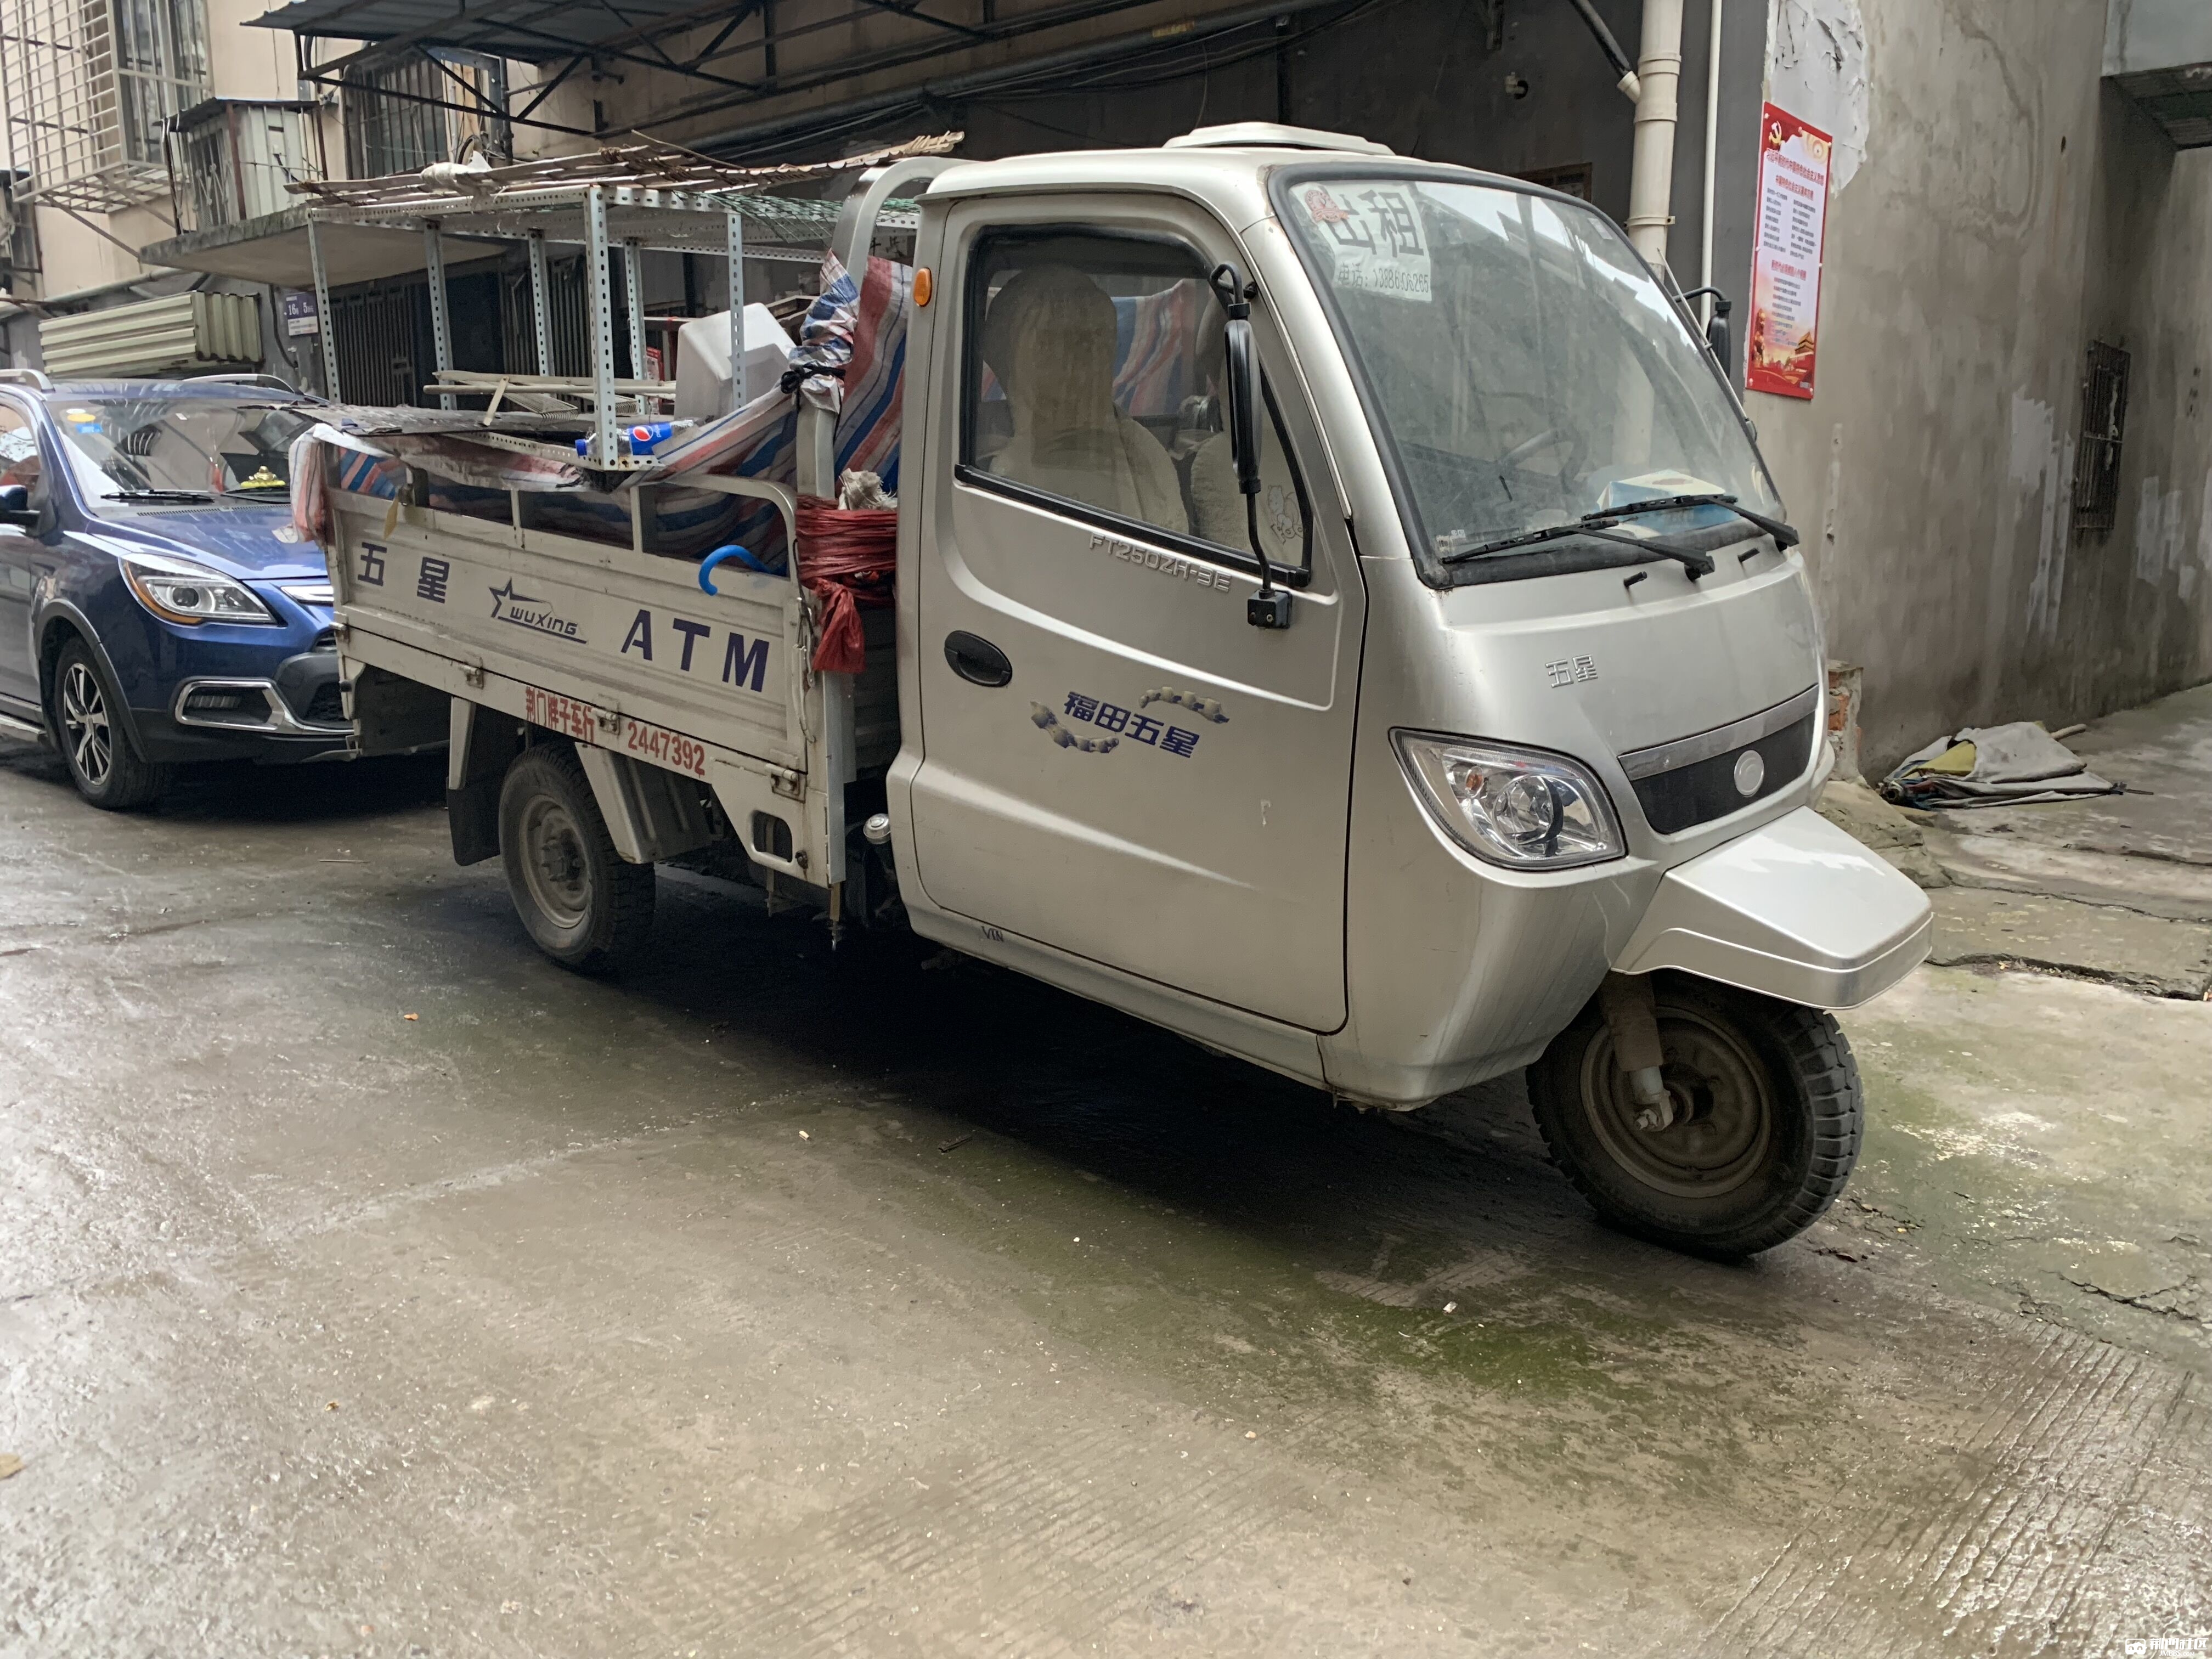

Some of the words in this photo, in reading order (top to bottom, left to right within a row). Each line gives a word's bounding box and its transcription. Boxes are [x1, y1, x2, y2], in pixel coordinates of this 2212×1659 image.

[1318, 185, 1424, 257] 出租
[358, 541, 450, 604] 五星
[620, 609, 770, 693] ATM
[1544, 654, 1598, 688] 五星
[627, 721, 706, 777] 2447392
[1063, 691, 1200, 758] 福田五星
